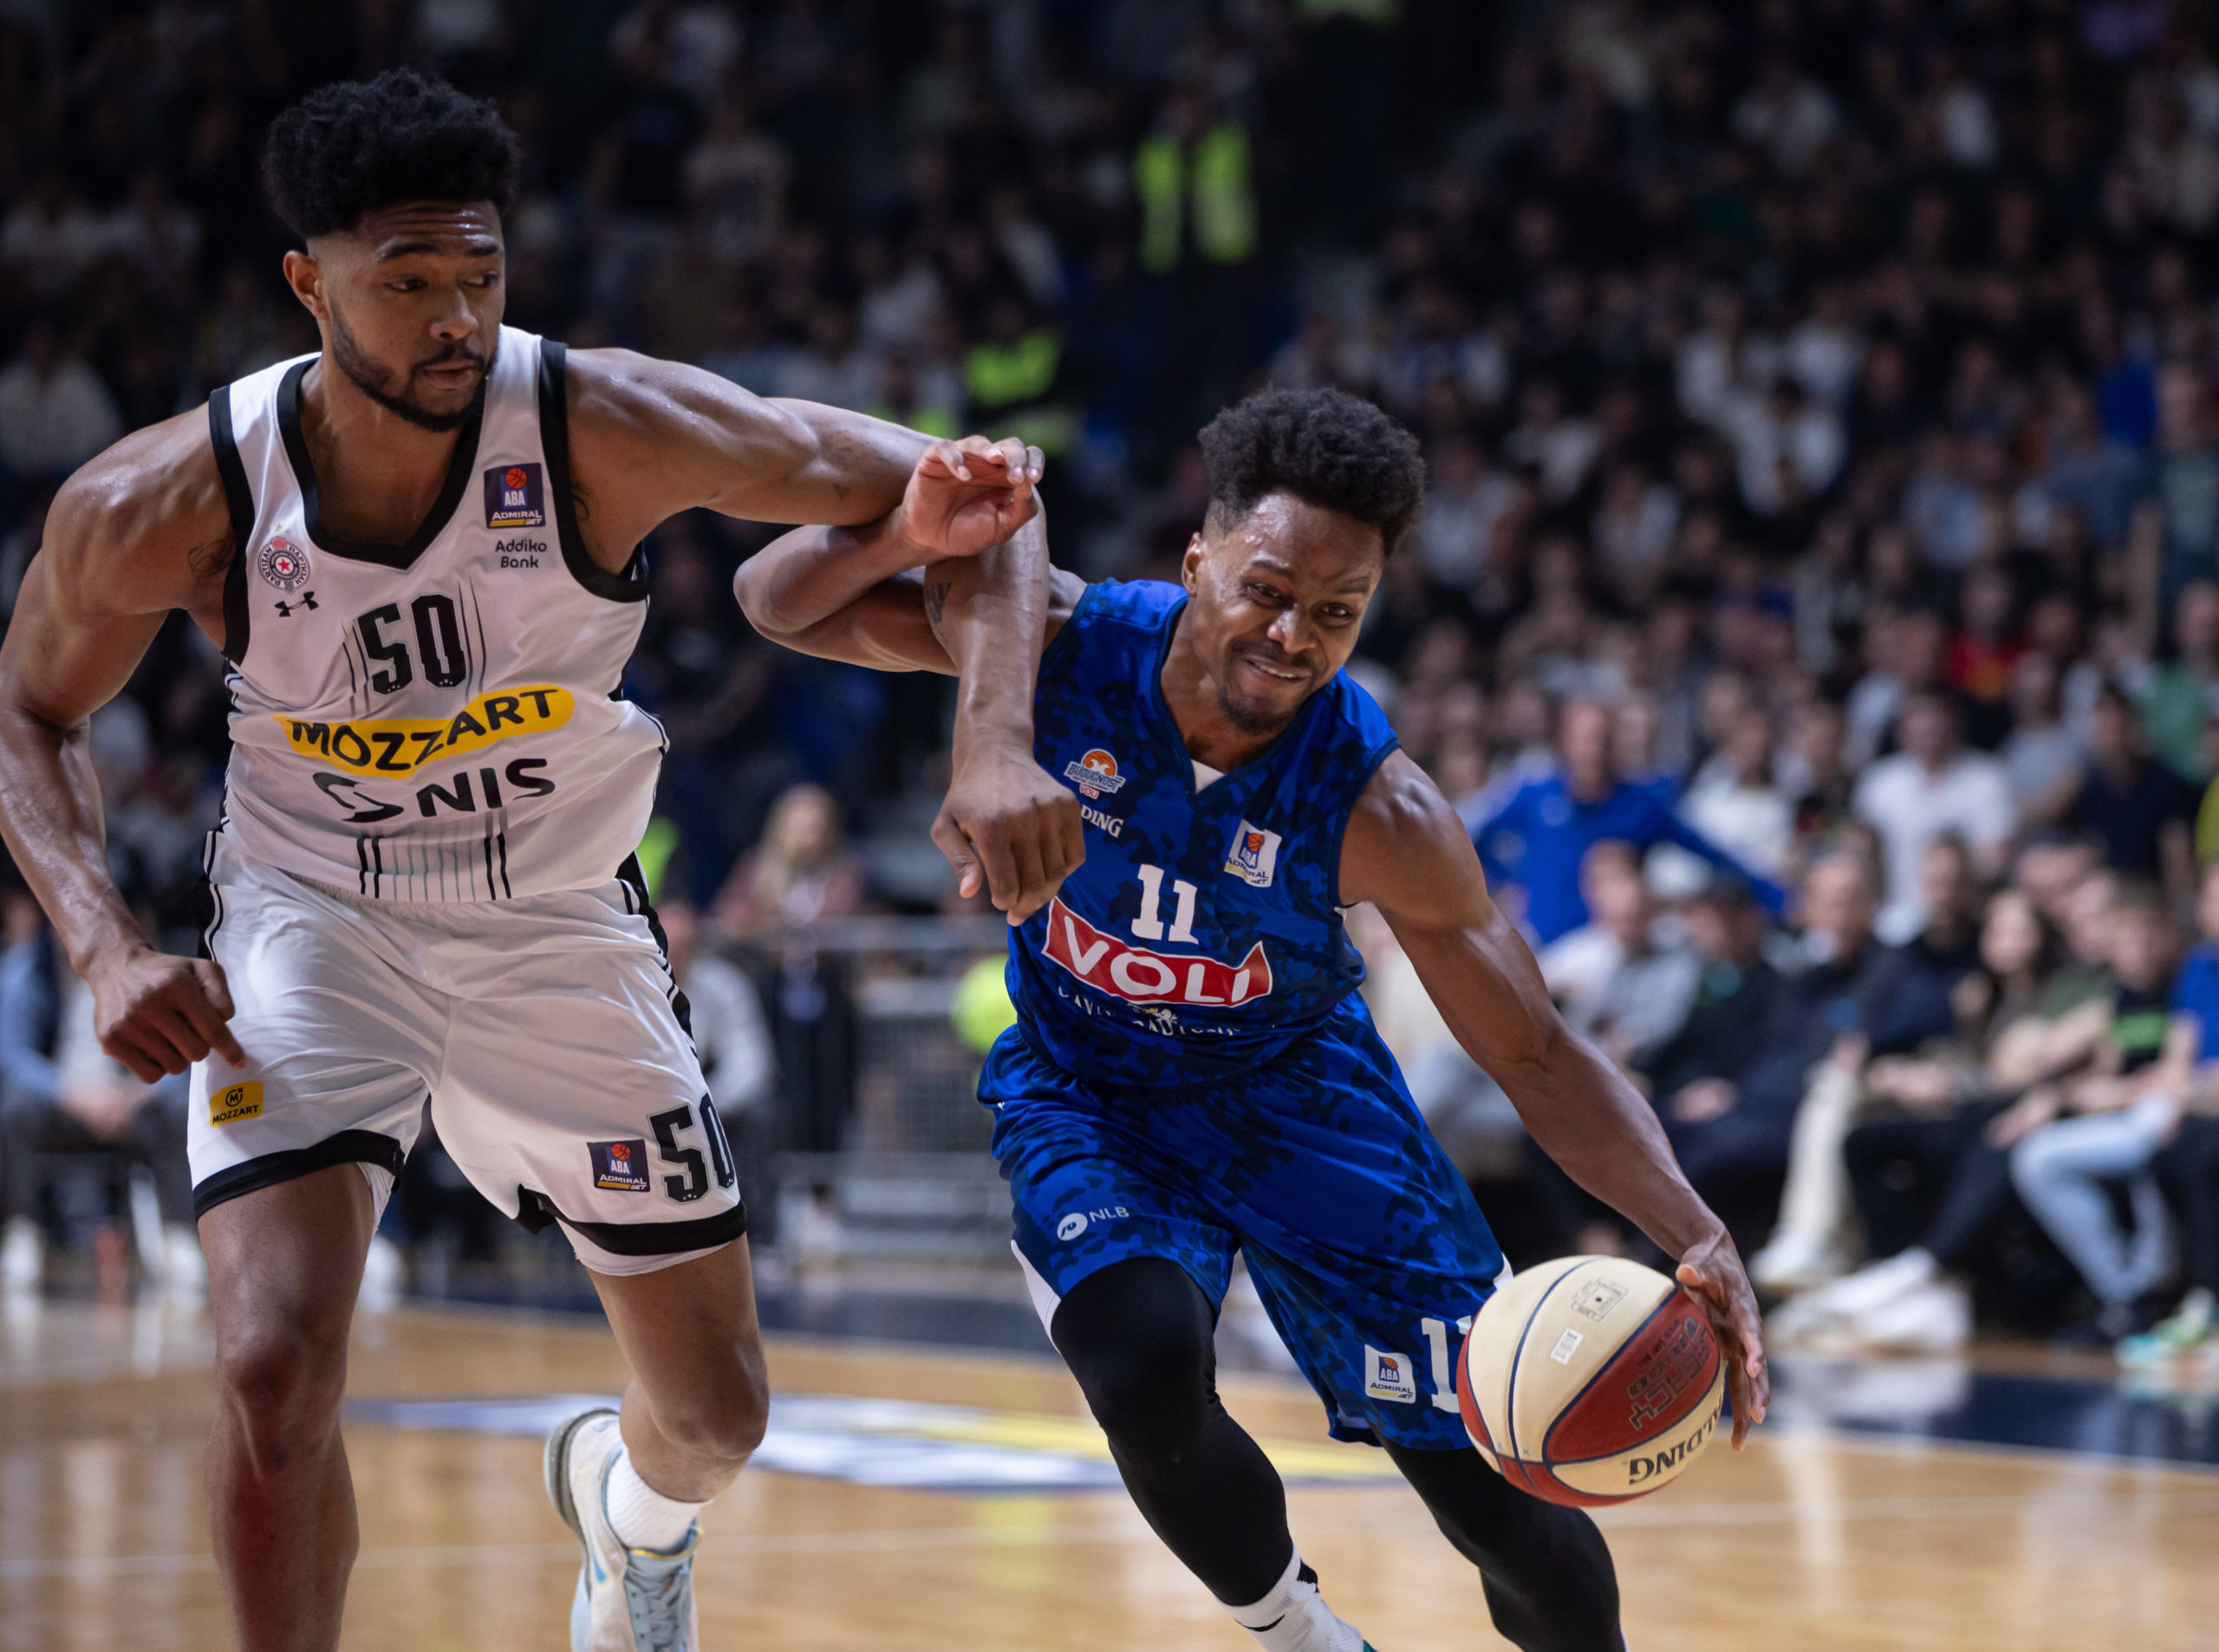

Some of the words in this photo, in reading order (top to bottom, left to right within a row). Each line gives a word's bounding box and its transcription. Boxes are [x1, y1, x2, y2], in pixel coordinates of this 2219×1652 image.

[504, 491, 525, 507] ABA
[491, 510, 543, 521] ADMIRAL
[495, 538, 548, 553] Addiko
[500, 555, 539, 569] Bank
[355, 594, 467, 695] 50
[290, 688, 559, 771] MOZZART
[415, 758, 556, 818] NIS
[1081, 803, 1124, 838] DING
[1227, 856, 1269, 879] ADMIRAL
[1131, 864, 1199, 945] 11
[1064, 914, 1251, 1004] VOLI
[212, 1105, 260, 1125] MOZZART
[647, 1090, 737, 1204] 50
[610, 1159, 630, 1174] ABA
[599, 1174, 647, 1185] ADMIRAL
[1089, 1206, 1129, 1222] NLB
[1421, 1315, 1472, 1414] 1
[1380, 1368, 1399, 1382] ABA
[1370, 1382, 1414, 1394] ADMIRAL
